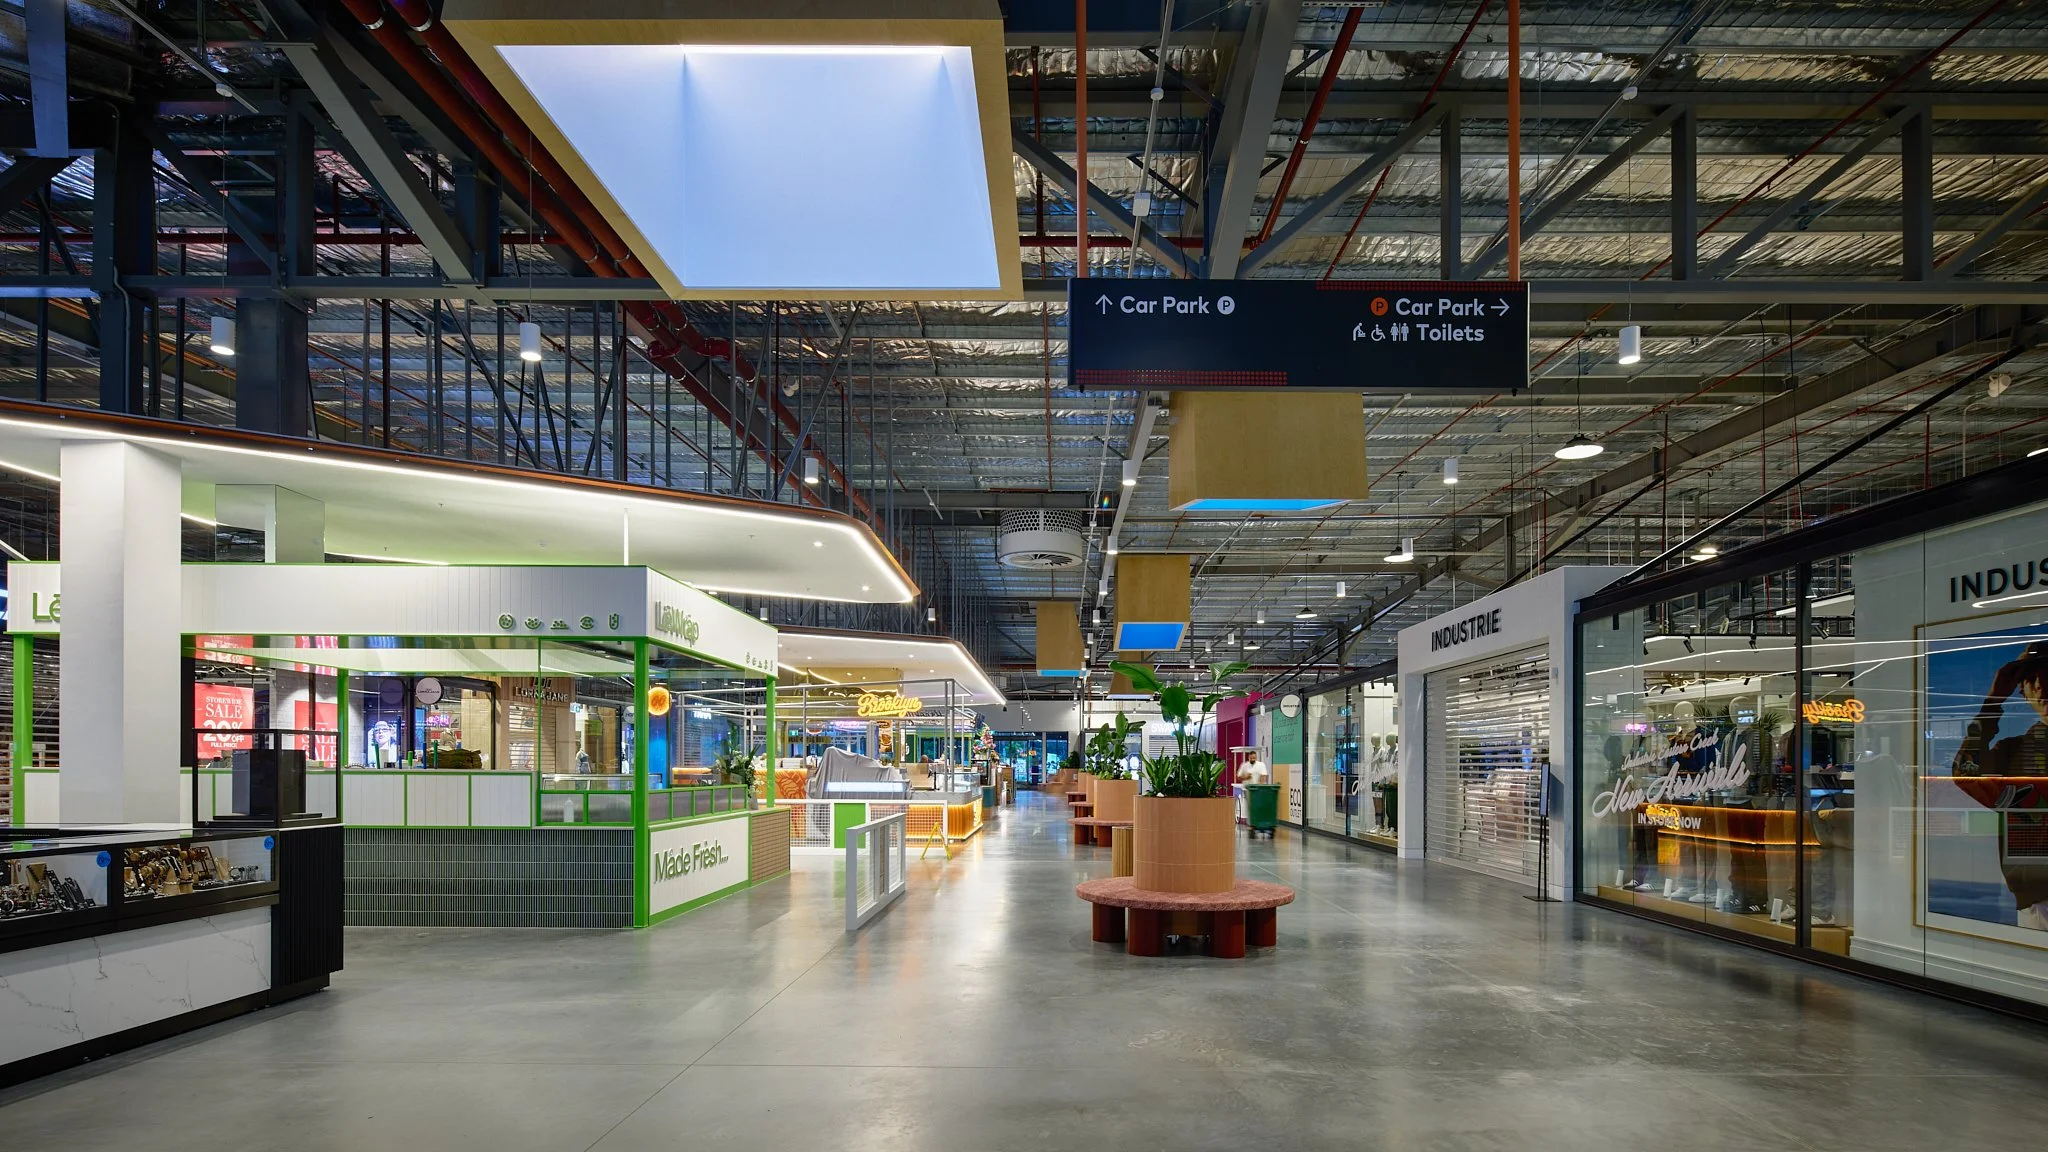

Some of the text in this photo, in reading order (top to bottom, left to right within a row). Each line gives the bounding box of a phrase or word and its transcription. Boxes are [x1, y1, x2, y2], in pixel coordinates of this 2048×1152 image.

[1120, 296, 1157, 314] Car
[1163, 296, 1210, 314] Park
[1395, 298, 1433, 316] Car
[1438, 298, 1485, 316] Park
[1416, 323, 1485, 342] Toilets
[1431, 608, 1502, 652] INDUSTRIE
[206, 696, 242, 706] STOREWIDE
[546, 689, 569, 703] JANE
[205, 703, 243, 719] SALE
[232, 735, 244, 743] OFF
[1689, 727, 1719, 751] Creek
[1592, 774, 1645, 818] New
[1646, 743, 1750, 803] Arrivals
[1638, 812, 1646, 824] IN
[1678, 817, 1701, 830] NOW
